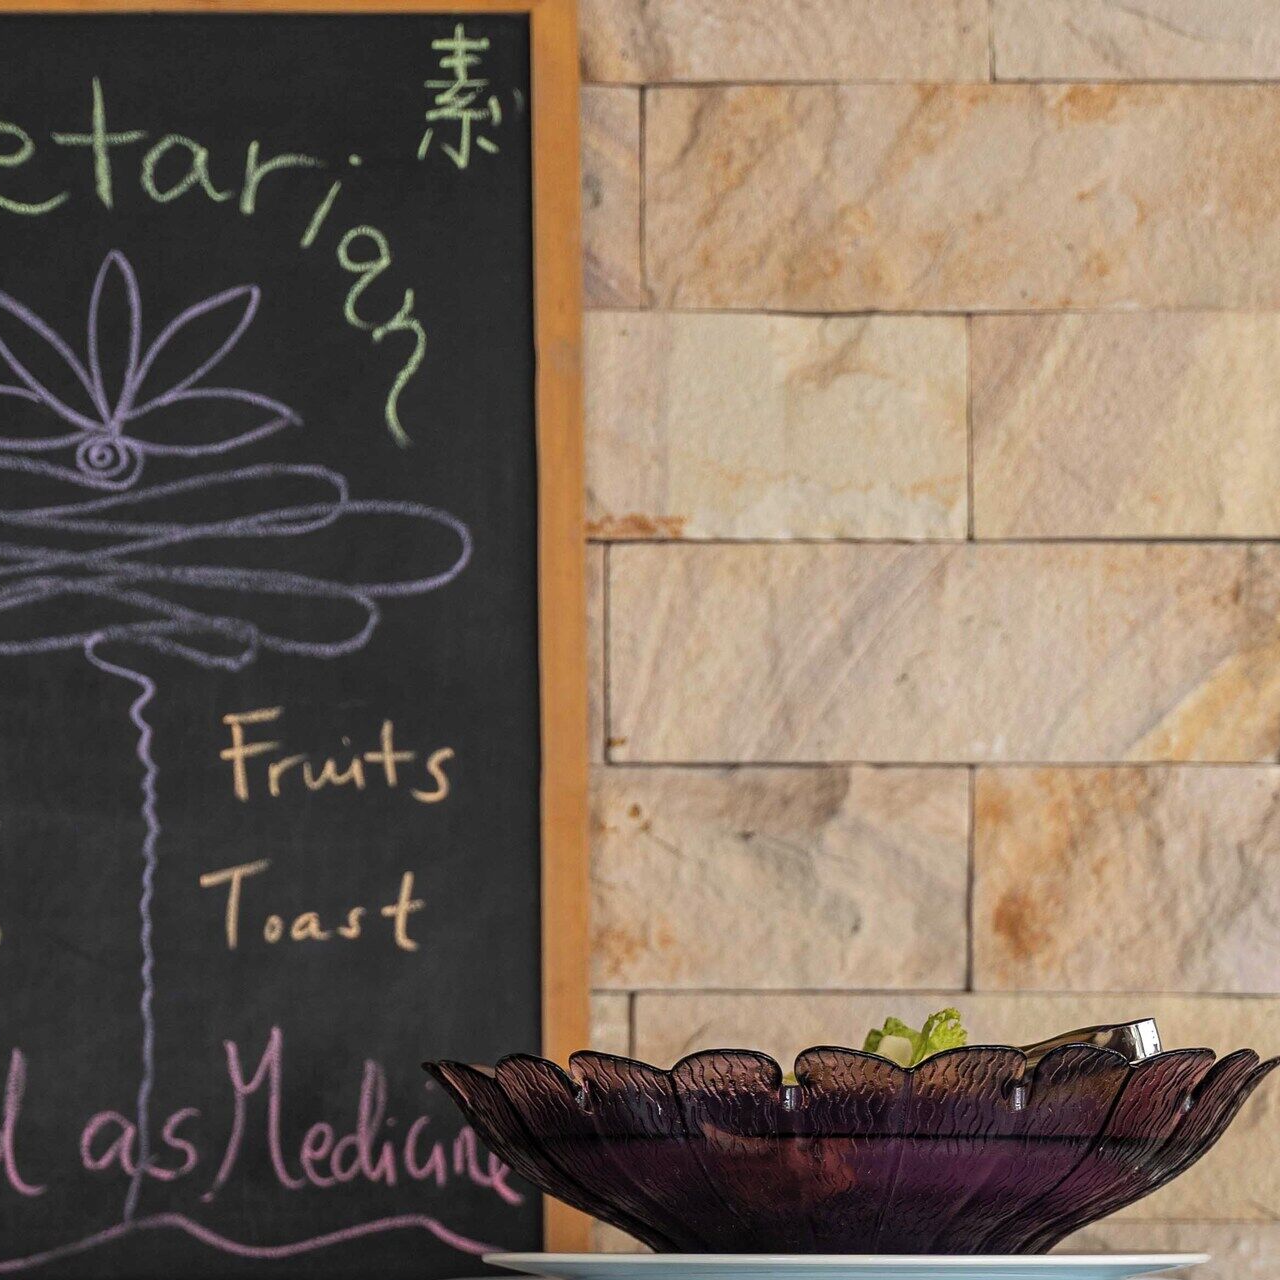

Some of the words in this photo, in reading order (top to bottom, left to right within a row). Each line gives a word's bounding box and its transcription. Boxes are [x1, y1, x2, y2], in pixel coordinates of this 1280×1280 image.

[417, 22, 502, 170] 素
[218, 706, 456, 802] Fruits
[199, 859, 426, 952] Toast
[80, 1106, 204, 1182] as
